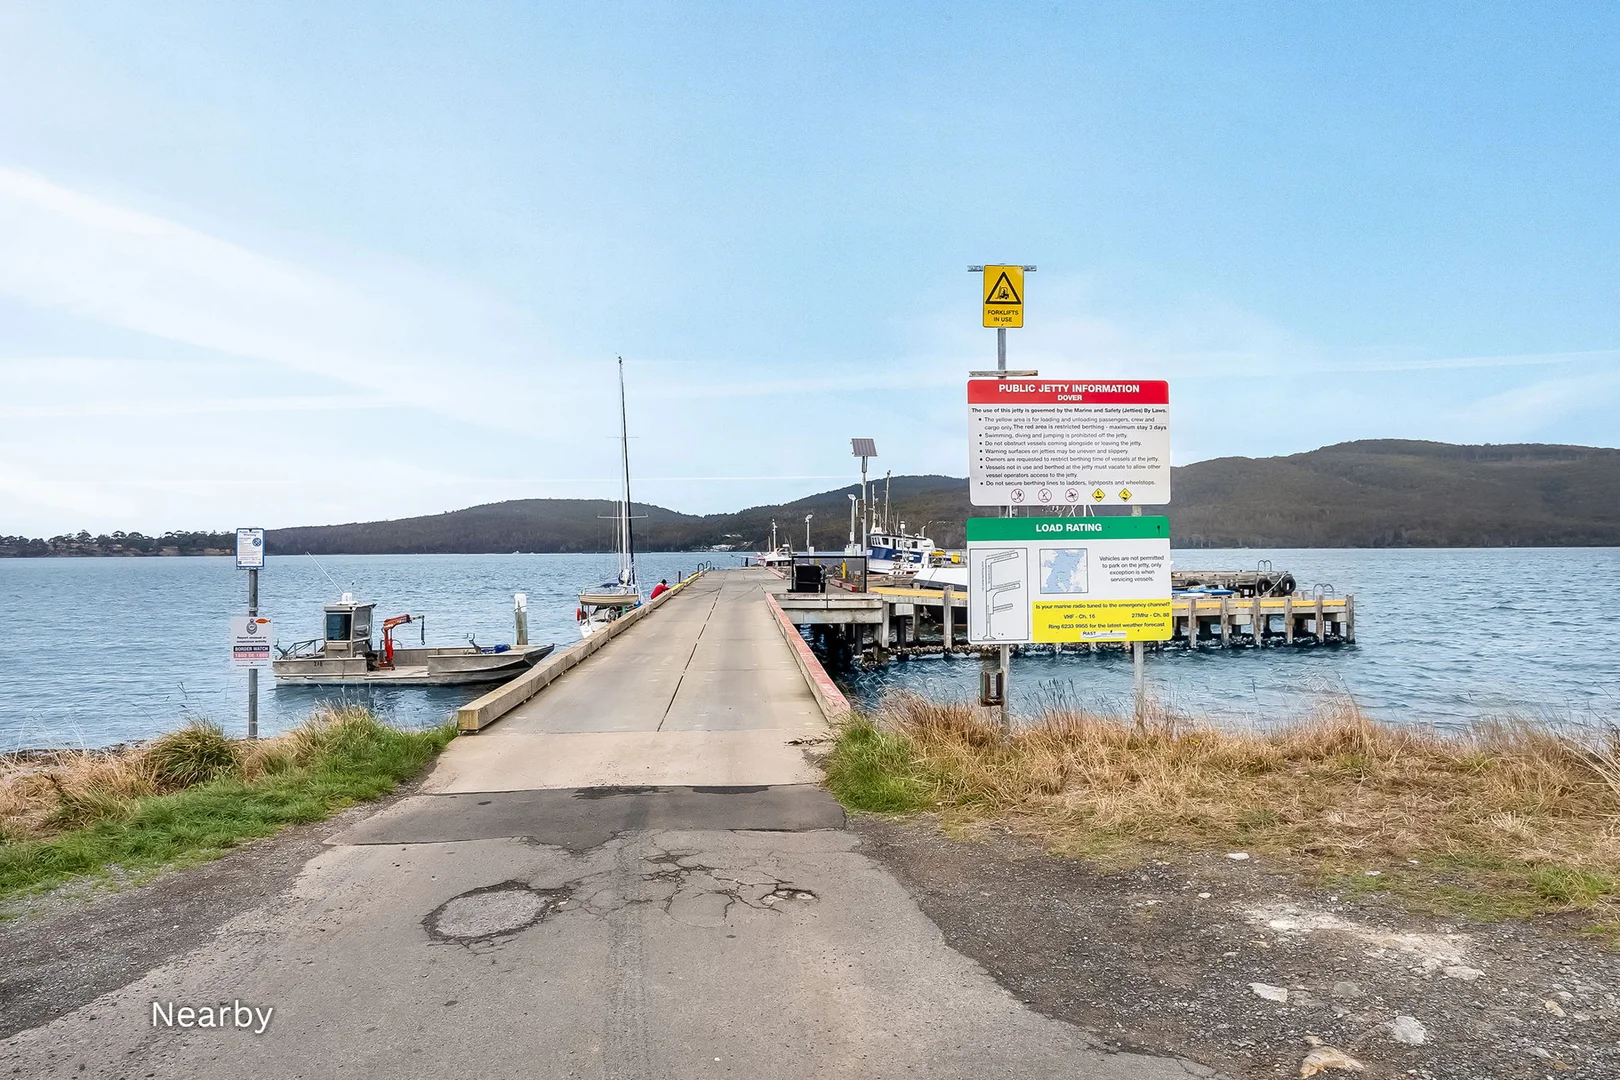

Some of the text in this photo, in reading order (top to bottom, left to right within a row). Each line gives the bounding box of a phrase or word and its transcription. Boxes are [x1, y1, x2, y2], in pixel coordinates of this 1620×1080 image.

[999, 384, 1140, 393] PUBLIC JETTY INFORMATION
[1036, 524, 1102, 532] LOAD RATING
